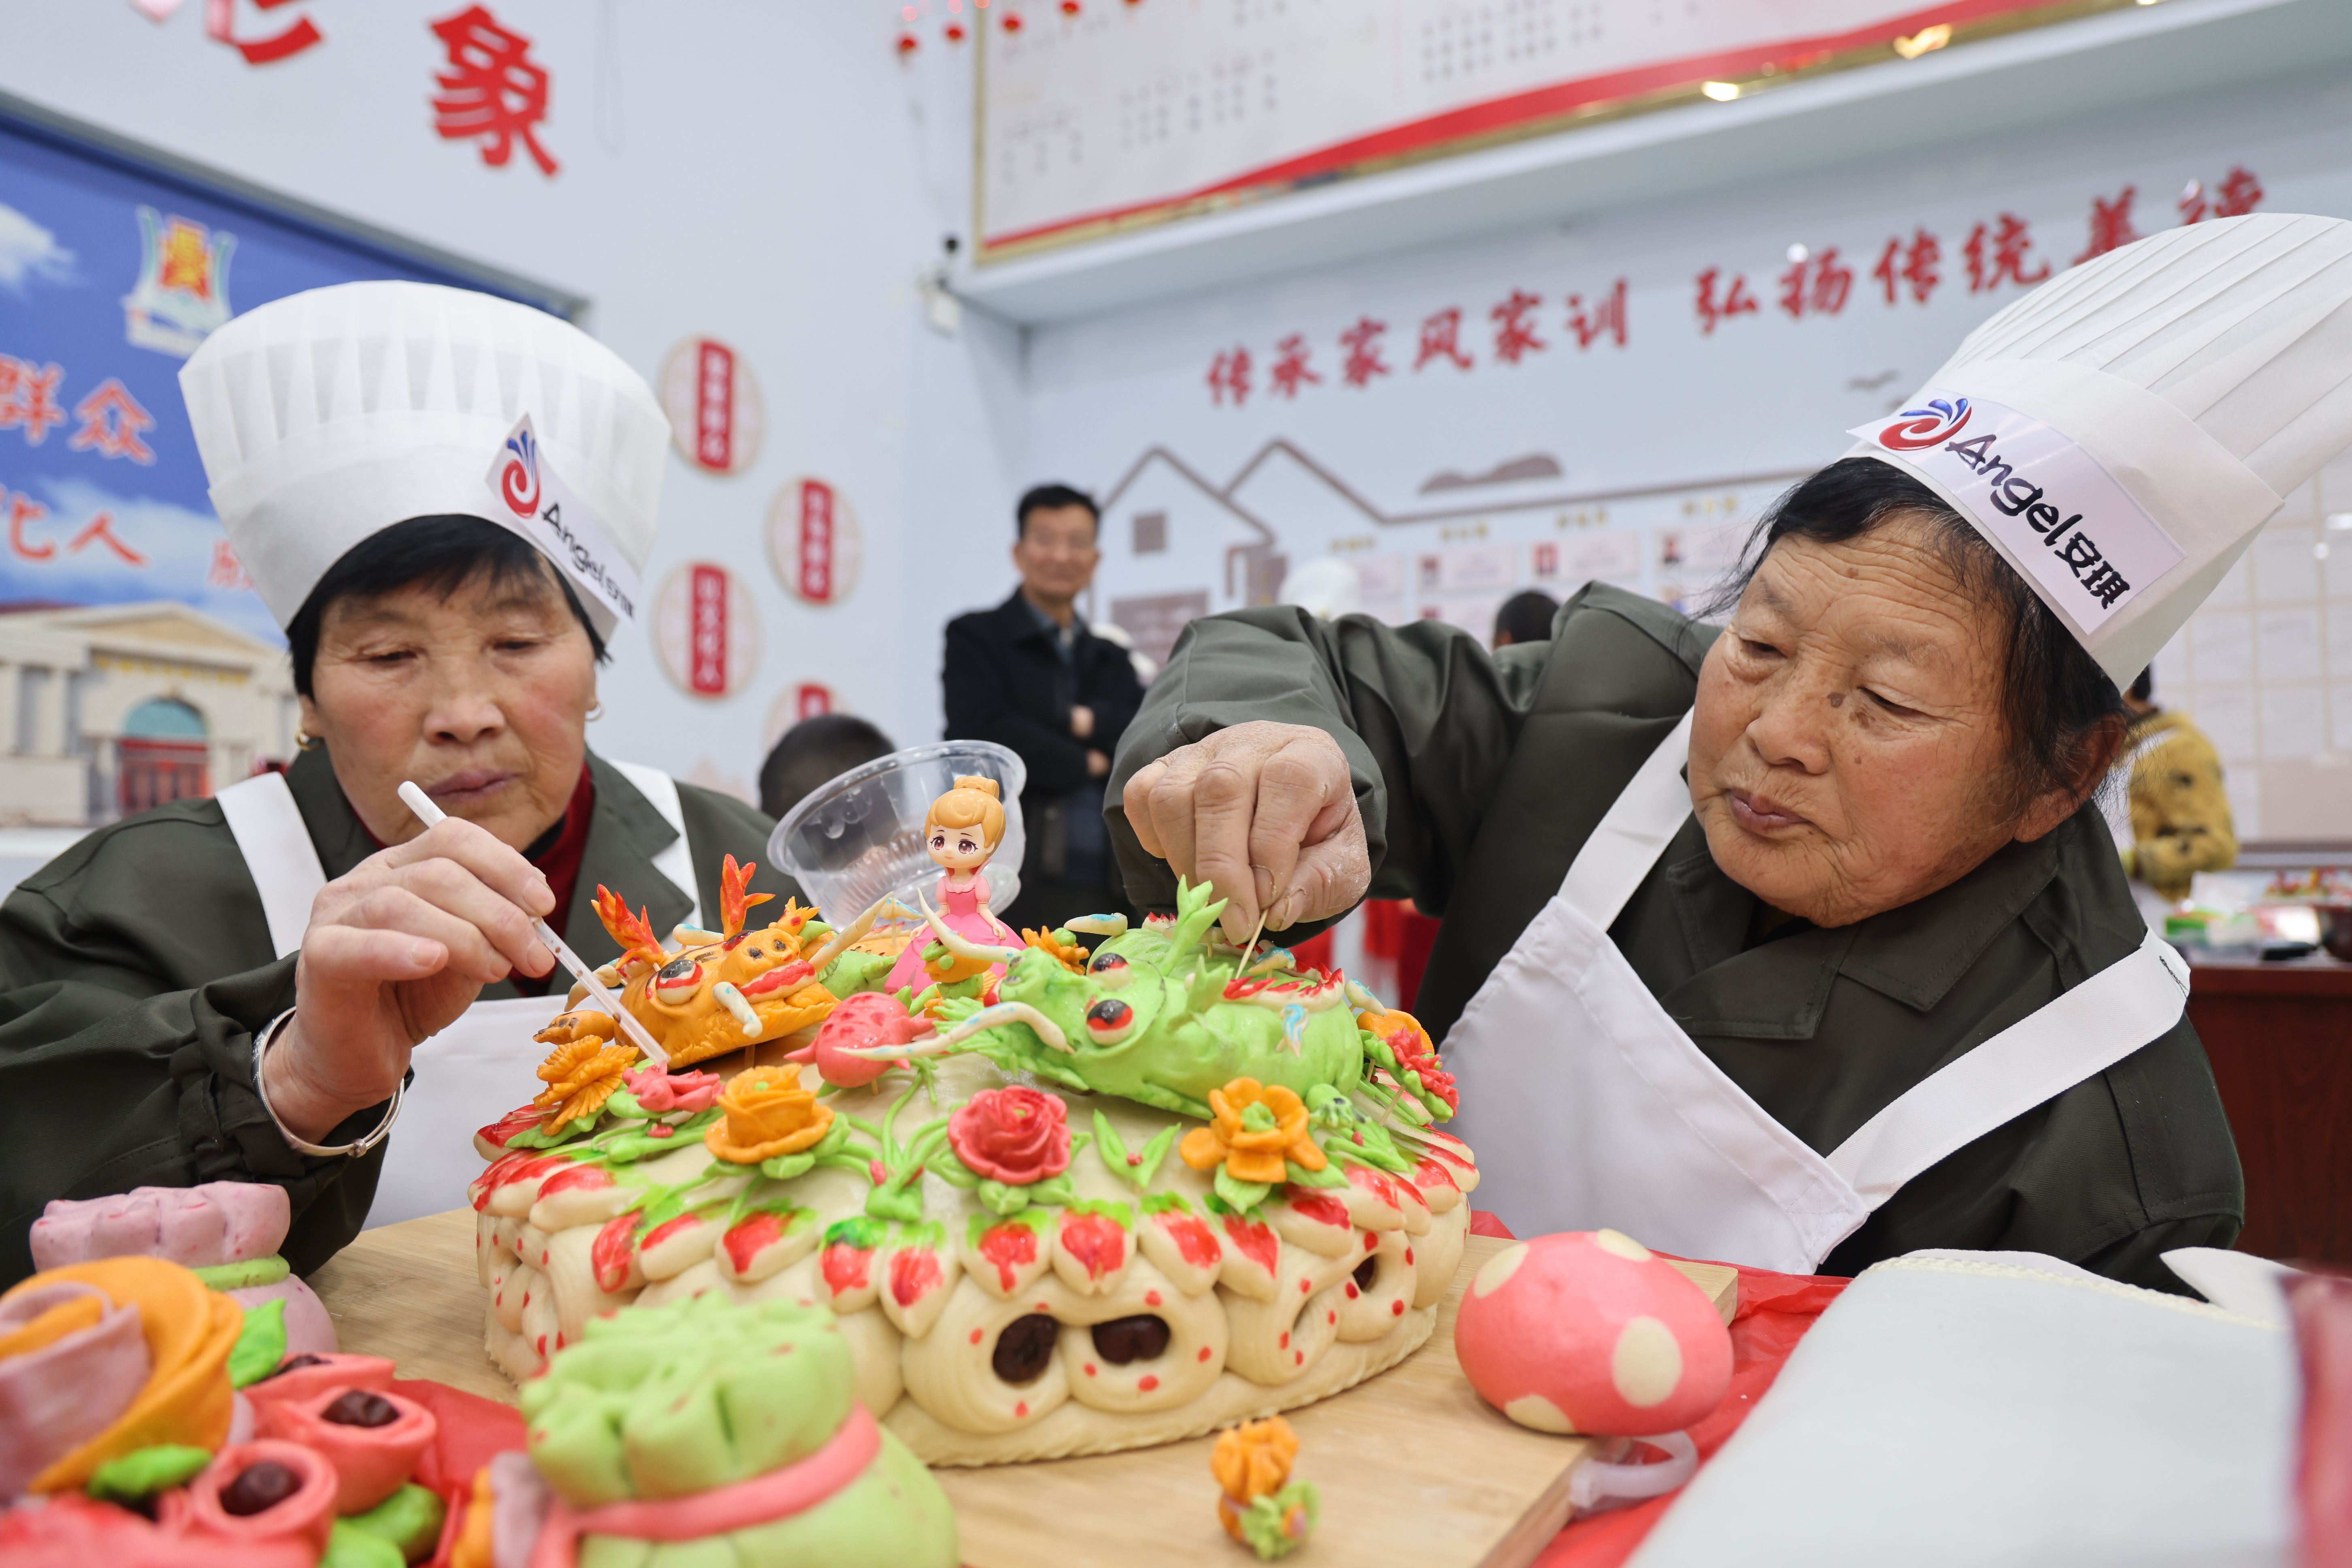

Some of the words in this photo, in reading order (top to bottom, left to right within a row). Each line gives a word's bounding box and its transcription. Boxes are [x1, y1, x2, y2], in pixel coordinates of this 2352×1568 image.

[1206, 276, 1629, 407] 传承家风家训
[1945, 434, 2083, 547] Angel
